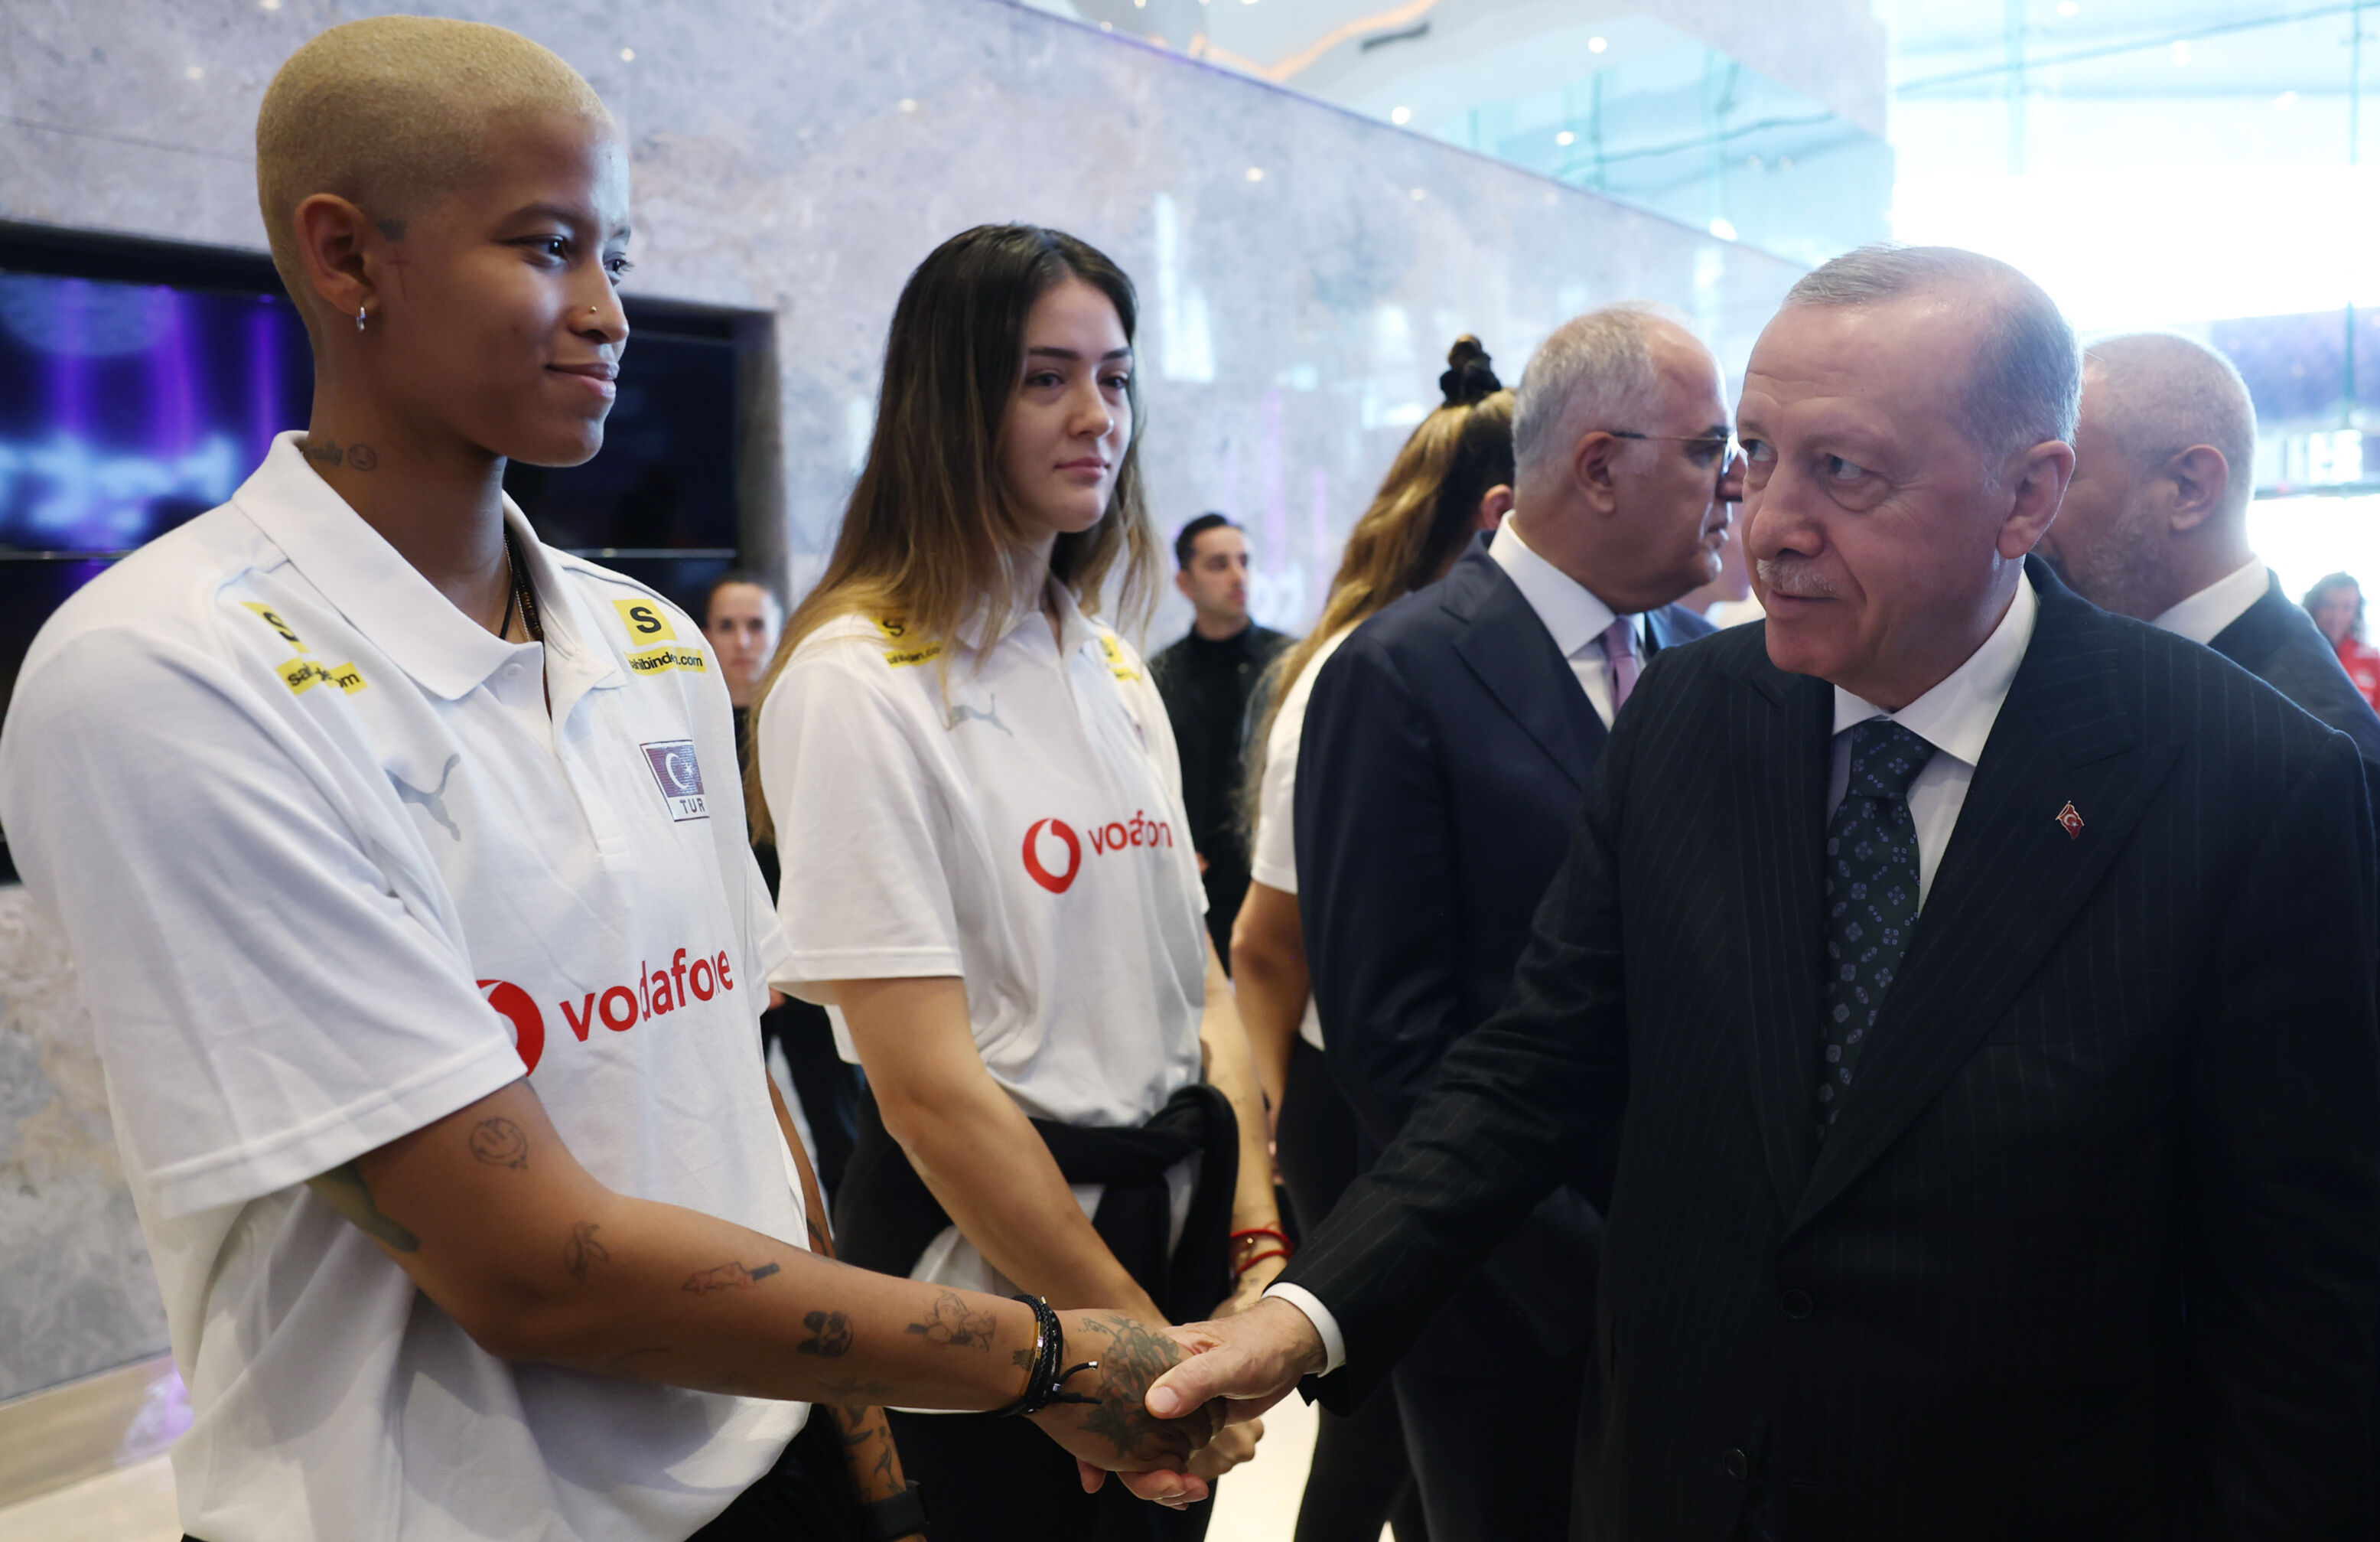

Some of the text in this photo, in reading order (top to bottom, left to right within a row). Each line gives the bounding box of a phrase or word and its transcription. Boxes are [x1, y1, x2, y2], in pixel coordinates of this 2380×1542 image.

[263, 611, 300, 642] S
[630, 607, 662, 634] S
[679, 797, 705, 814] TUR
